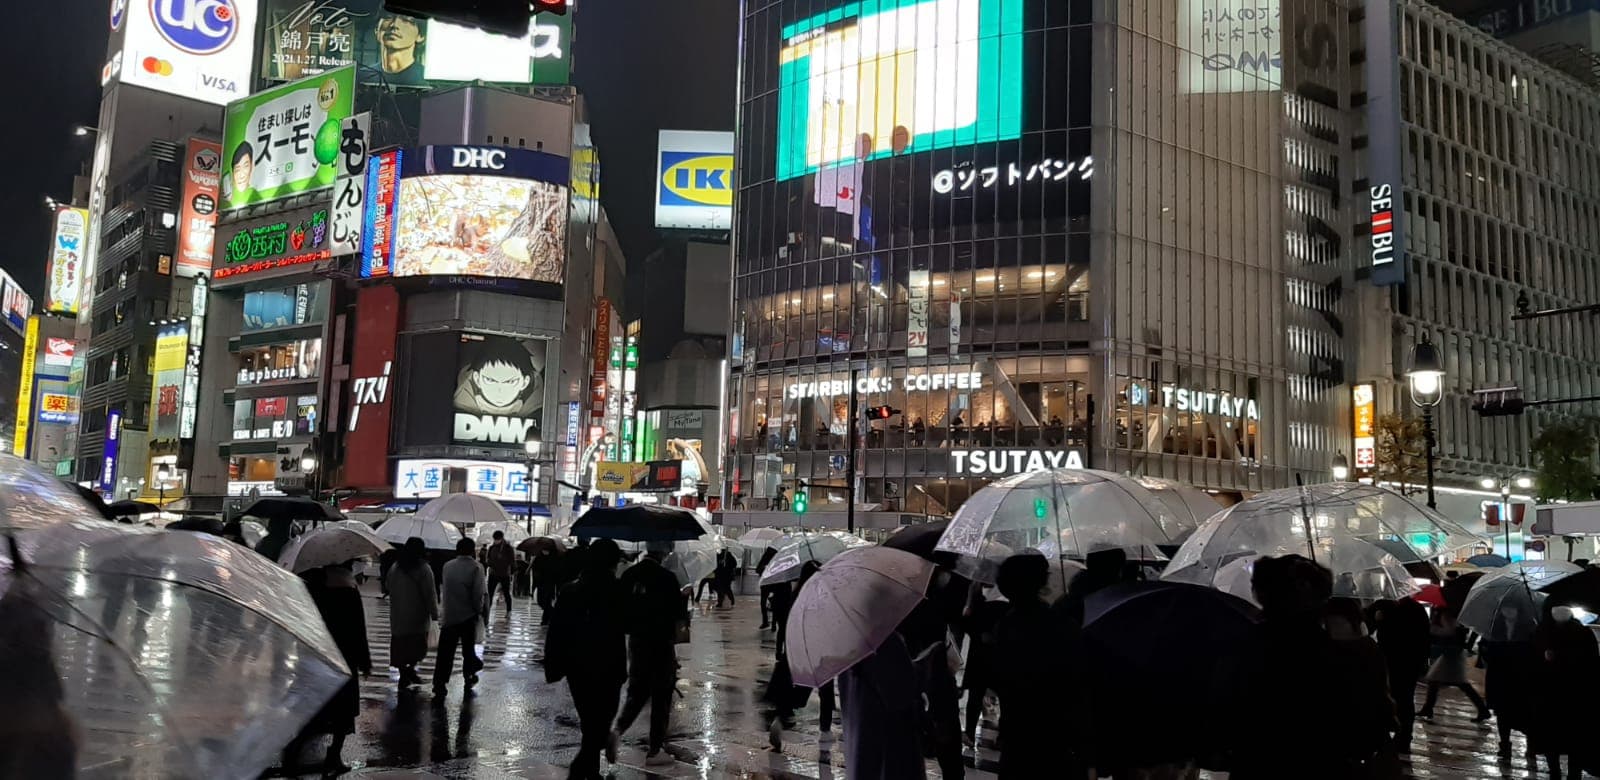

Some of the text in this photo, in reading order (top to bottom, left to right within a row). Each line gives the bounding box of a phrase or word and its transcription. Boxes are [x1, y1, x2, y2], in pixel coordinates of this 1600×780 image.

[280, 29, 350, 53] 錦戸亮
[202, 74, 238, 94] VISA
[257, 104, 312, 133] 住まい探しは
[254, 122, 310, 166] スーモ
[452, 147, 506, 170] DHC
[333, 118, 366, 251] もんじゃ
[675, 168, 734, 189] IK
[1370, 183, 1394, 267] SEIBU
[251, 231, 286, 257] 西村
[240, 366, 296, 384] Euphoria
[789, 371, 982, 399] STARBUCKS COFFEE
[1161, 386, 1259, 420] TSUTAYA
[454, 412, 537, 443] DMM
[951, 450, 1084, 474] TSUTAYA
